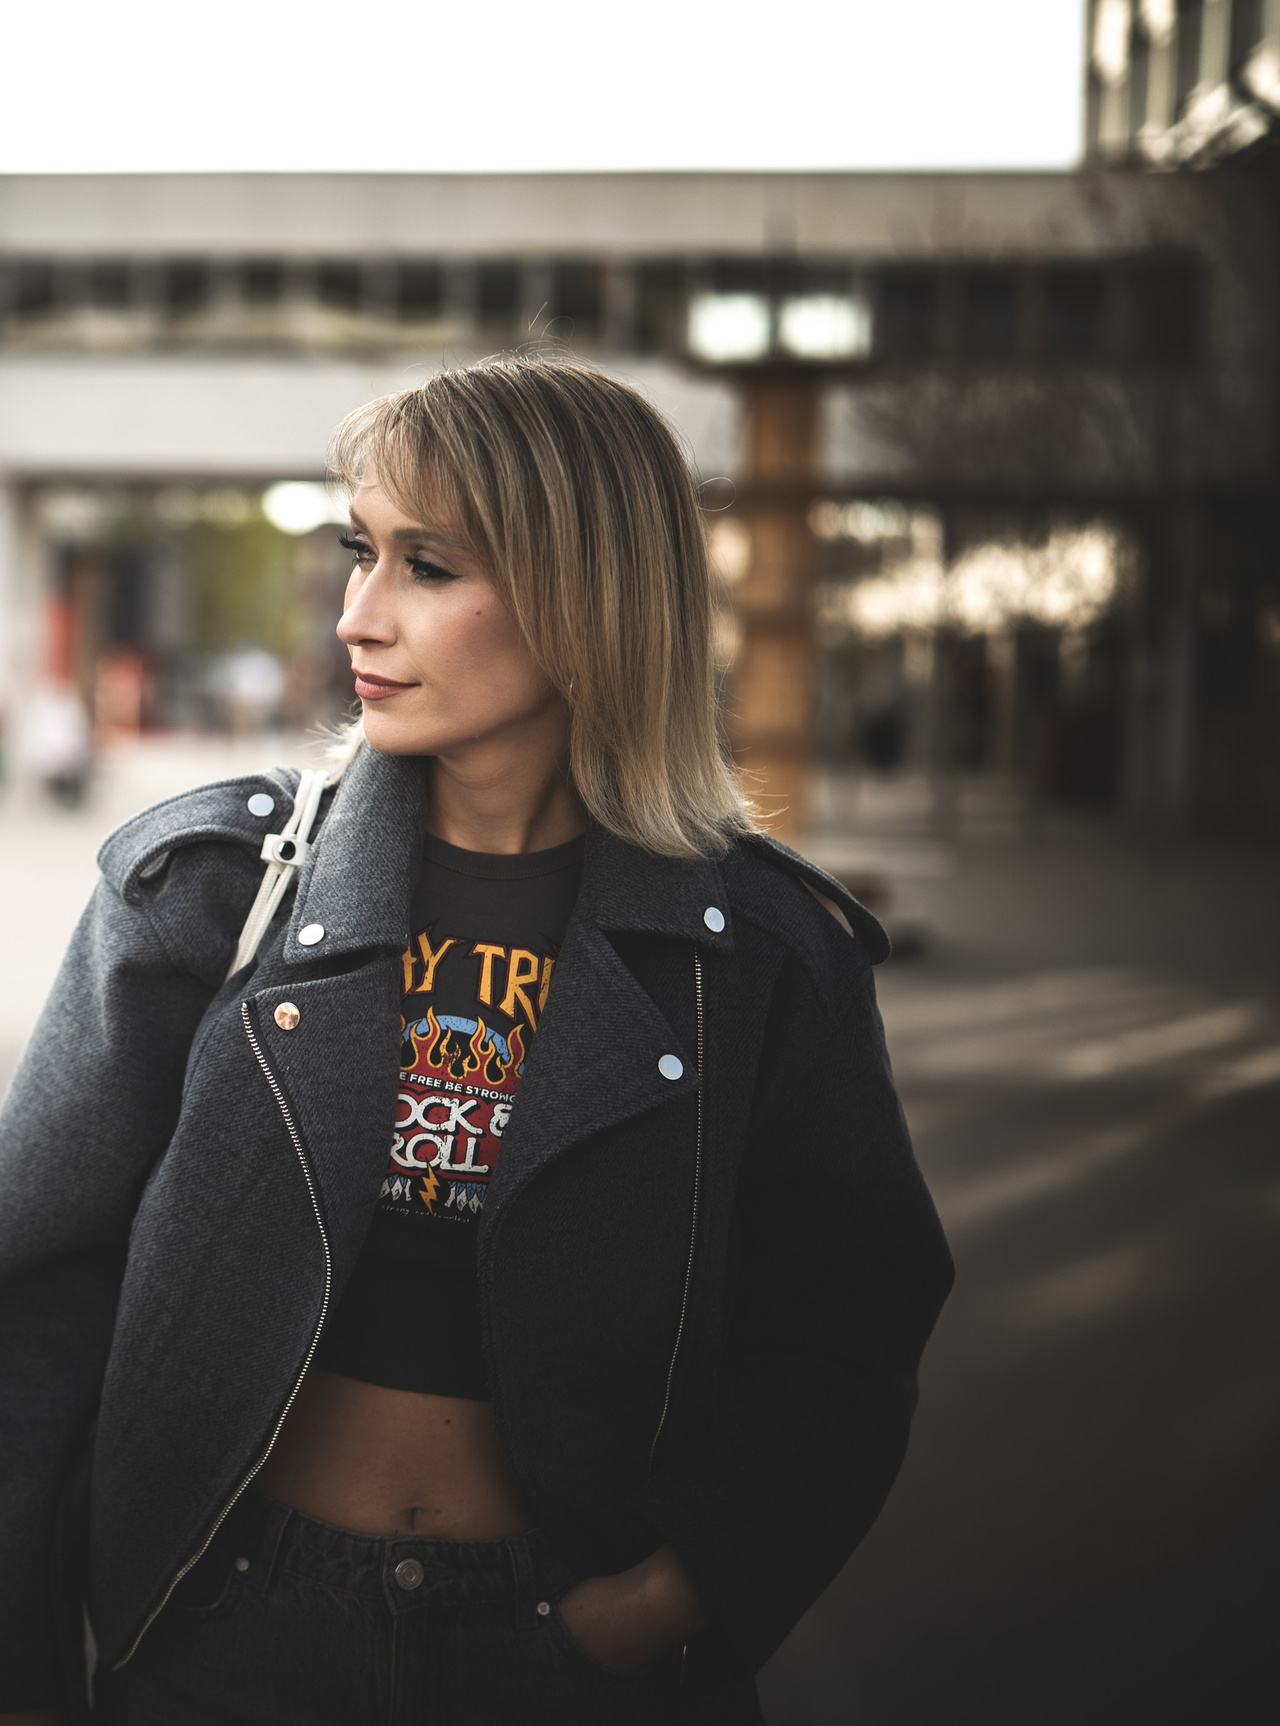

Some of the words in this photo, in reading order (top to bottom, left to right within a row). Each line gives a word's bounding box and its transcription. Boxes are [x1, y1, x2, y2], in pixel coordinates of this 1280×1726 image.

[410, 1074, 442, 1088] FREE
[445, 1081, 463, 1092] BE
[390, 1132, 489, 1173] ROLL
